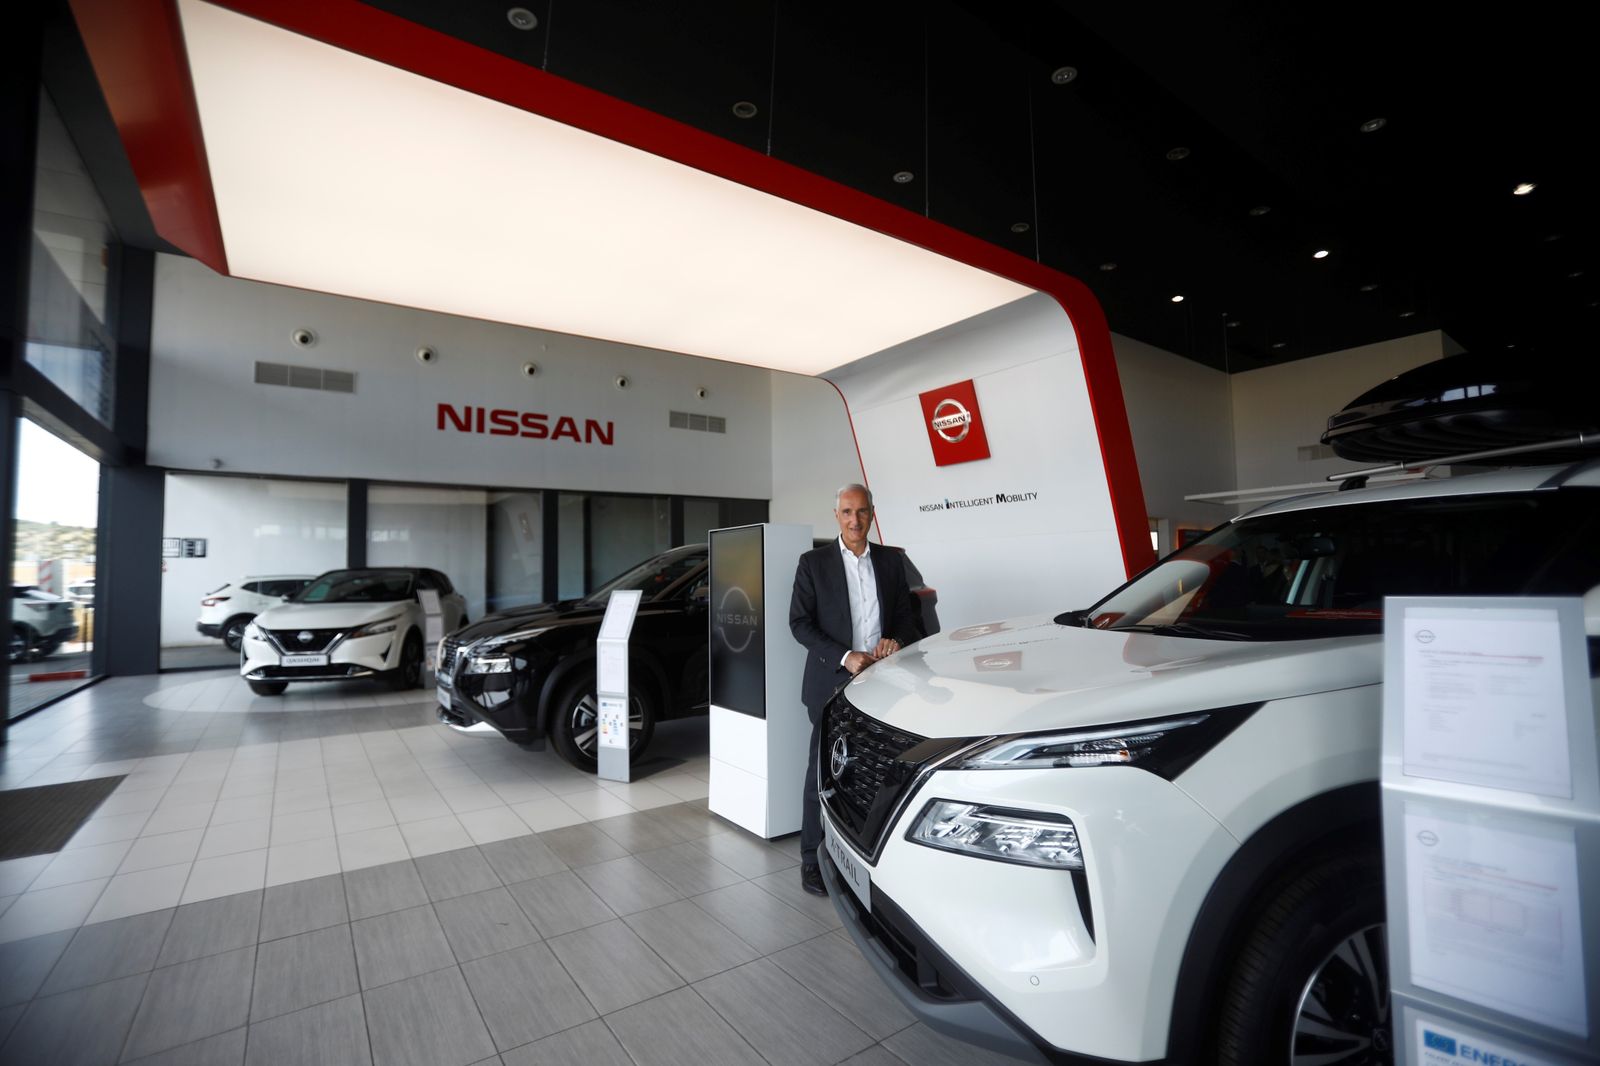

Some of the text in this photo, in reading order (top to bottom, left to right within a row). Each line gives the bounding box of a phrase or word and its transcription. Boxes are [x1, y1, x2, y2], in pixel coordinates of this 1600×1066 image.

[437, 403, 614, 446] NISSAN
[934, 415, 966, 428] NISSAN
[919, 492, 1038, 512] NISSAN INTELLIGENT MOBILITY
[716, 612, 758, 626] NISSAN
[830, 835, 860, 887] X-TRAIL
[1460, 1044, 1527, 1066] ENER
